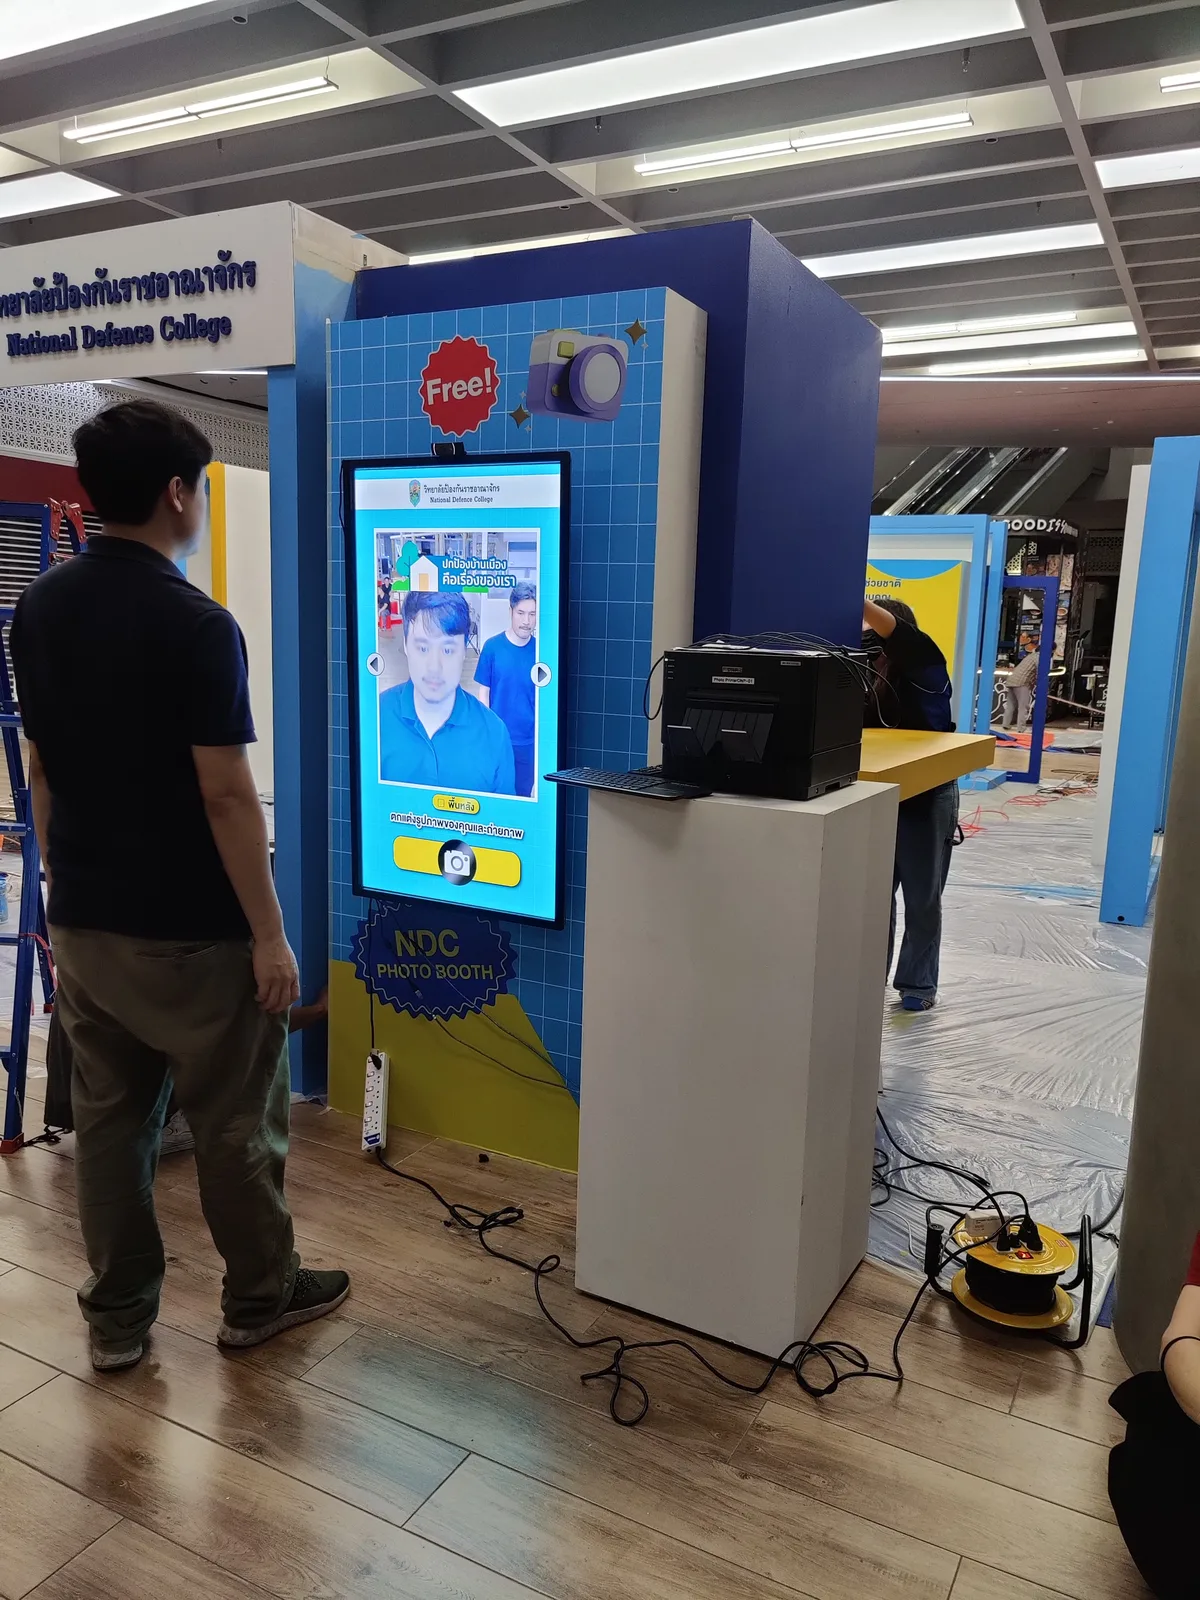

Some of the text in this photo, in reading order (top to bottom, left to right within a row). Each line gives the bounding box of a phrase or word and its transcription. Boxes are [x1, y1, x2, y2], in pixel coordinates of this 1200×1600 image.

[7, 312, 232, 357] National Defence College
[426, 367, 492, 406] Free!
[423, 483, 501, 494] วิทยาลัยป้องกันราชอาณาจักร
[474, 495, 494, 503] College
[442, 557, 507, 570] ปกป้องบ้านเมือง
[442, 570, 516, 587] คือเรื่องของเรา
[447, 796, 475, 812] พื้นหลัง
[390, 812, 524, 840] ตกแต่งรูปภาพของคุณและถ่ายภาพ
[394, 928, 461, 957] NDC
[376, 963, 494, 980] PHOTO BOOTH
